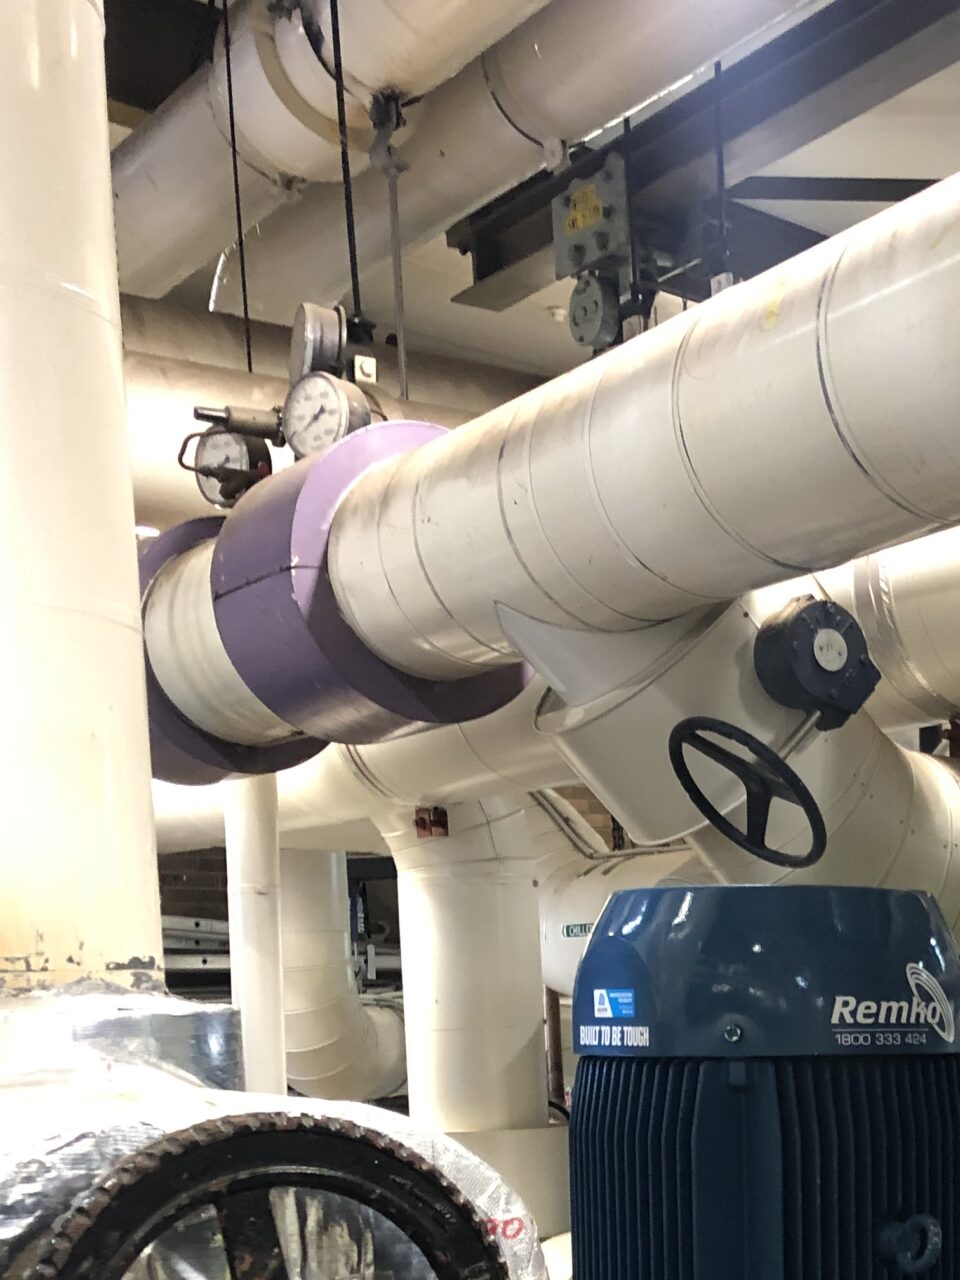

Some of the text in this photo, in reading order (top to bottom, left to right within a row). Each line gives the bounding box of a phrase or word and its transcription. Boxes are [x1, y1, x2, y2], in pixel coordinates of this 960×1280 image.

[831, 996, 940, 1024] Remko
[580, 1025, 650, 1047] BUILT TO BE TOUGH
[835, 1033, 927, 1046] 1800 333 424
